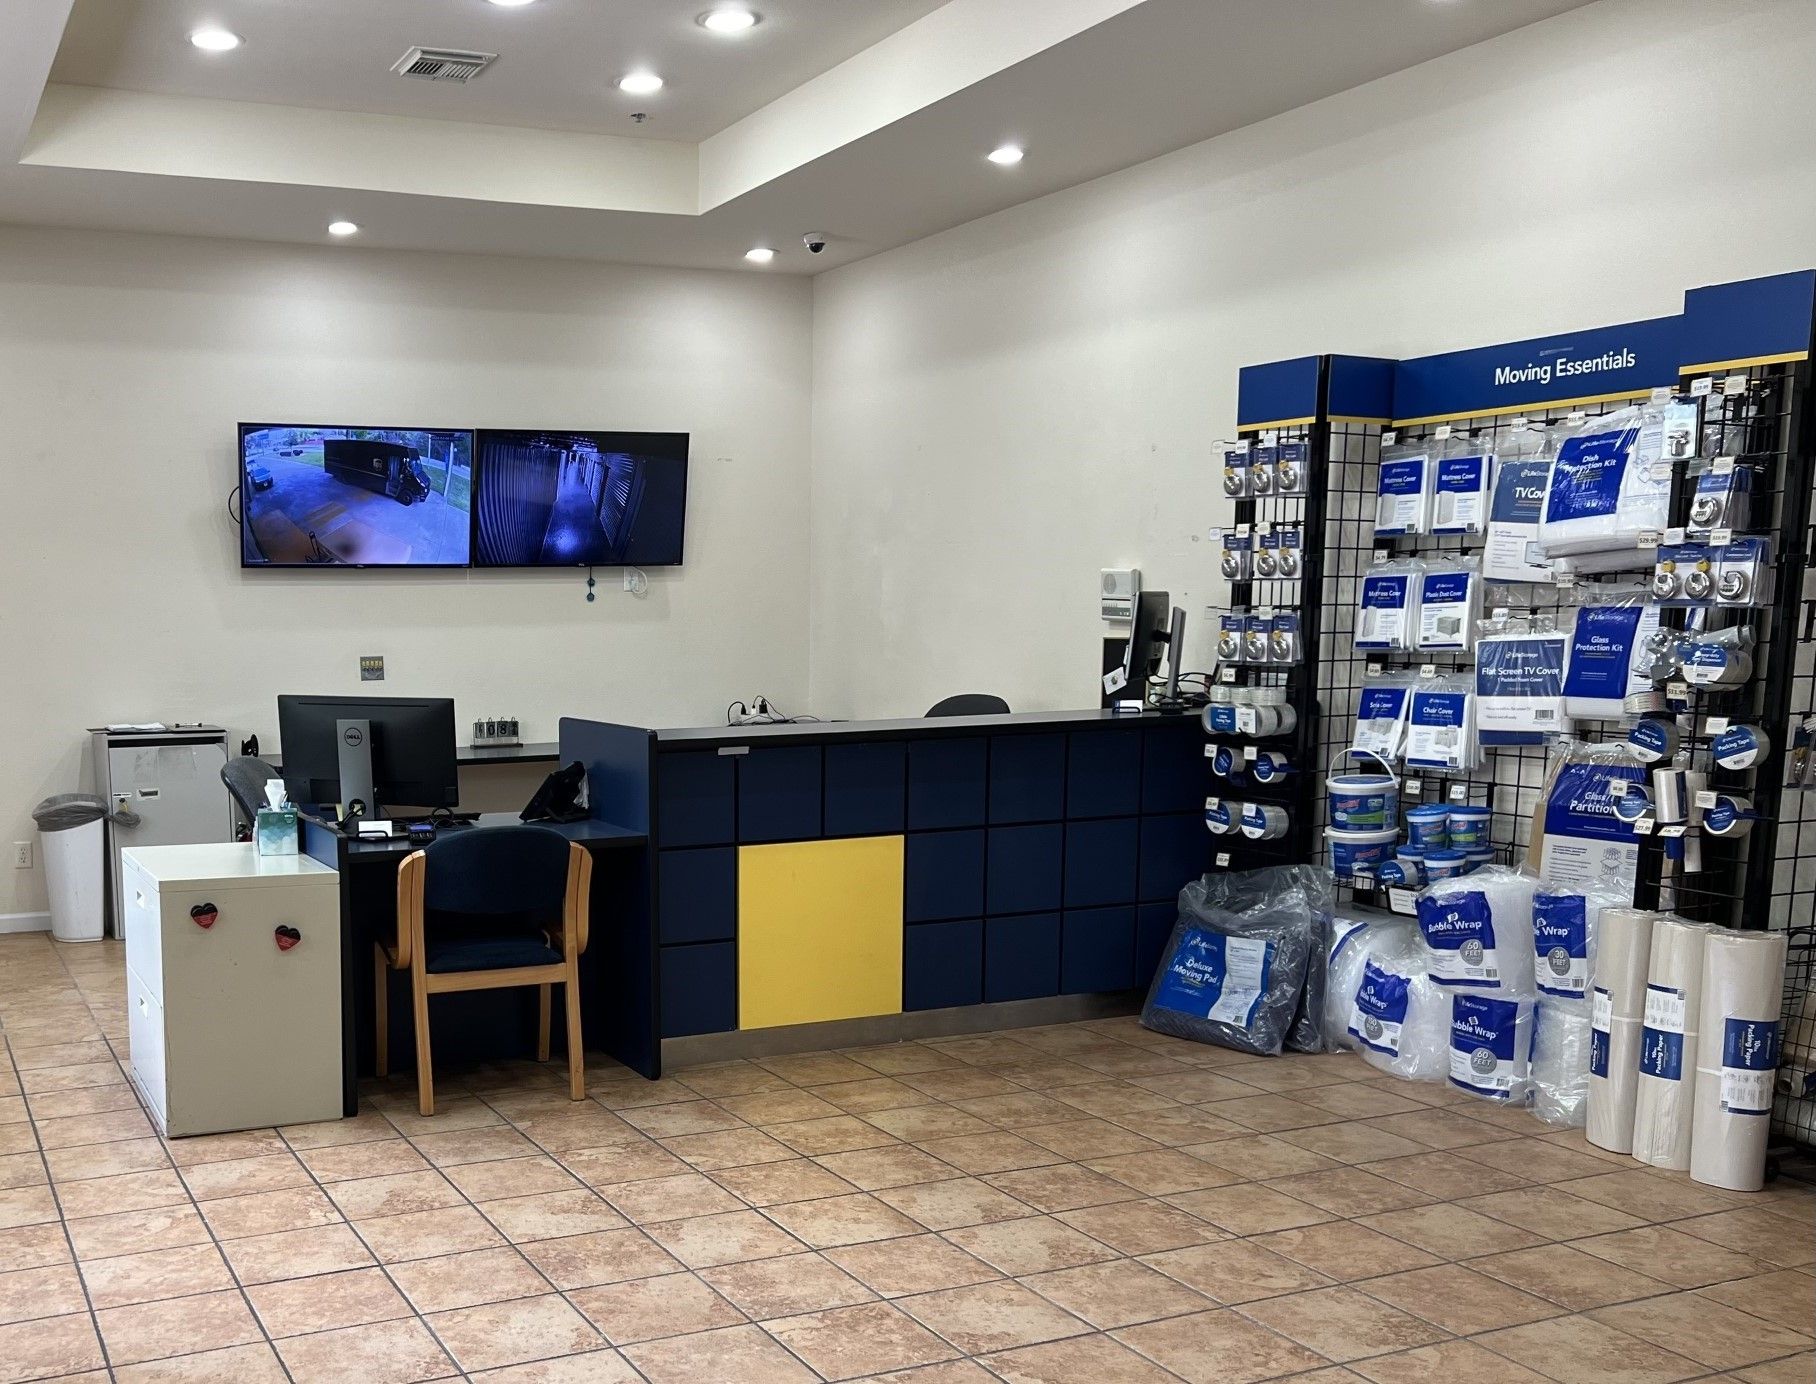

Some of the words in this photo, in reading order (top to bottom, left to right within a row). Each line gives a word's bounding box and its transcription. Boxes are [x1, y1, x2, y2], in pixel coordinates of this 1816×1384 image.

[1494, 363, 1551, 385] Moving
[1555, 348, 1636, 377] Essentials
[1582, 454, 1599, 463] Dish
[1603, 458, 1617, 467] Kit
[1515, 487, 1529, 498] TV
[1528, 486, 1545, 498] Cov
[1591, 635, 1609, 644] Glass
[1575, 643, 1610, 652] Protection
[1611, 644, 1623, 652] Kit
[1481, 667, 1497, 676] Flat
[1498, 667, 1523, 675] Screen
[1524, 667, 1535, 675] TV
[1536, 666, 1560, 675] Cover
[1634, 731, 1650, 742] Packing
[1651, 737, 1662, 746] Tape
[1717, 742, 1738, 752] Packing
[1738, 738, 1750, 747] Tape
[1428, 921, 1453, 933] Bubble
[1453, 920, 1482, 930] Wrap
[1542, 925, 1568, 938] Wrap
[1467, 941, 1479, 950] 60
[1554, 950, 1564, 959] 30
[1184, 957, 1213, 973] Deluxe
[1552, 958, 1566, 966] FEET
[1173, 964, 1203, 981] Moving
[1203, 973, 1218, 984] Pad
[1370, 994, 1387, 1010] Wrap
[1475, 1026, 1497, 1041] Wrap
[1744, 1024, 1755, 1047] Packing
[1477, 1050, 1489, 1059] 60
[1744, 1048, 1754, 1066] Paper
[1473, 1057, 1492, 1067] FEET
[1655, 1050, 1664, 1074] Packing
